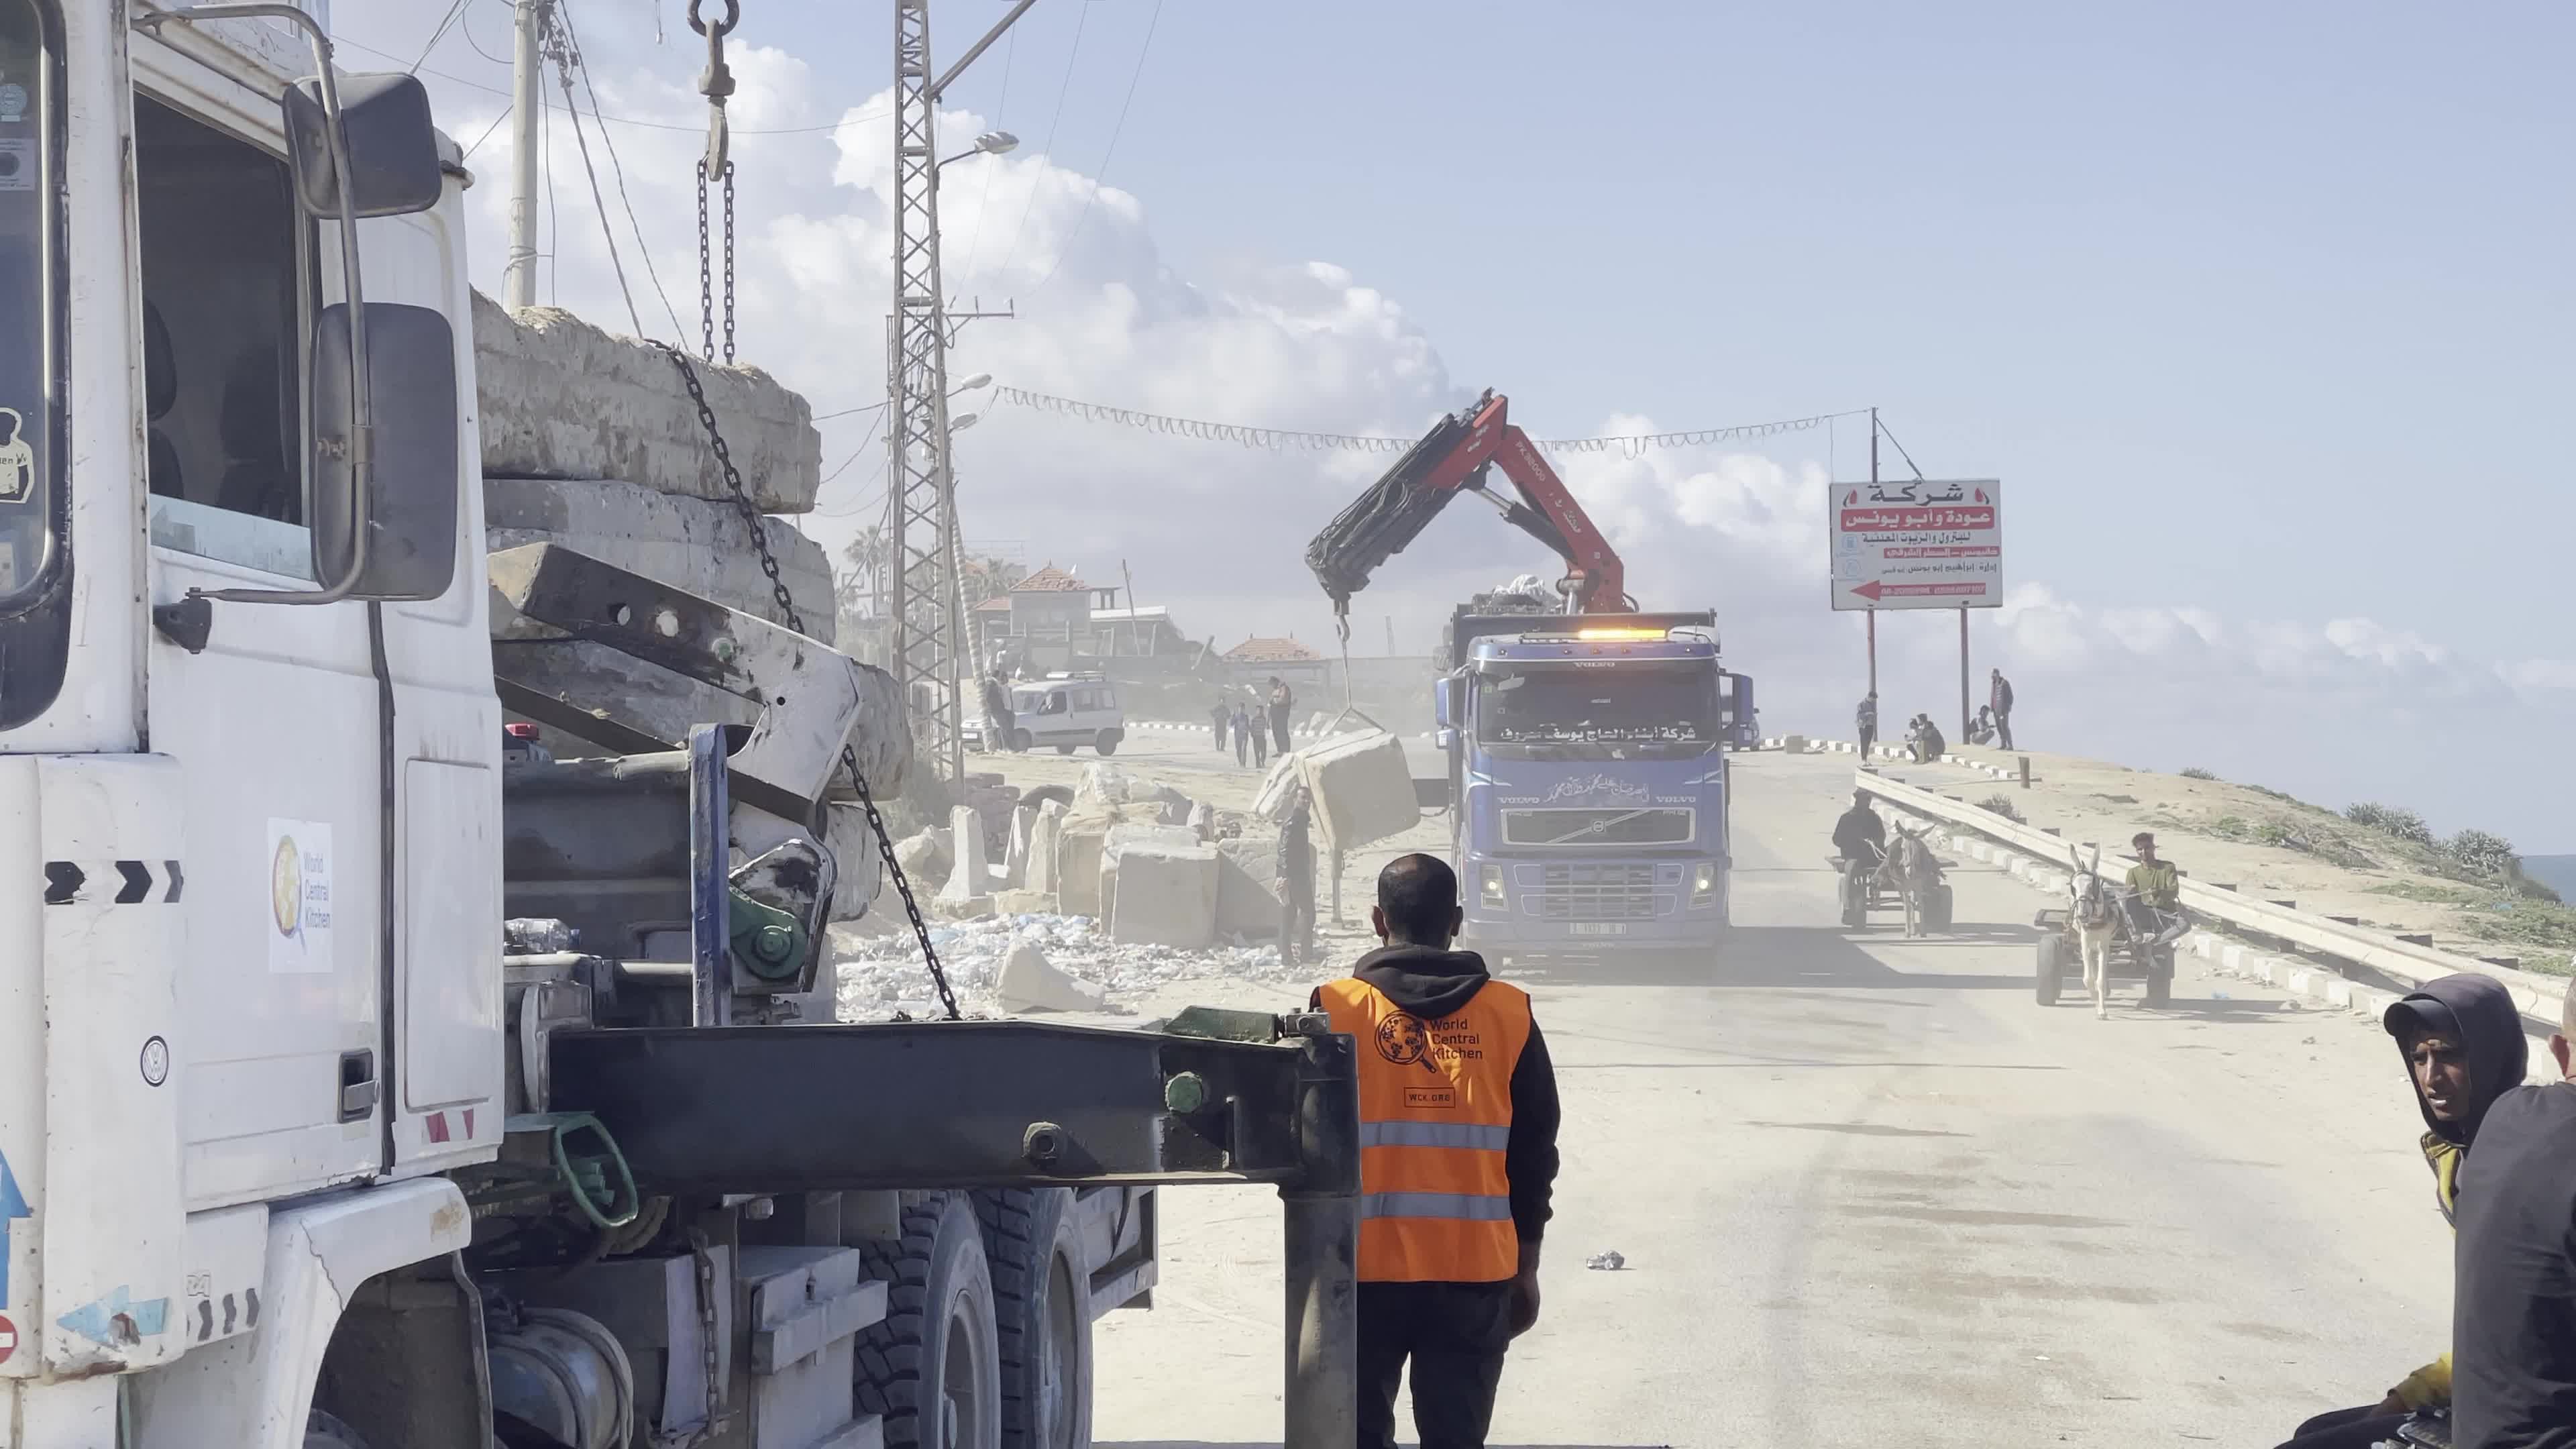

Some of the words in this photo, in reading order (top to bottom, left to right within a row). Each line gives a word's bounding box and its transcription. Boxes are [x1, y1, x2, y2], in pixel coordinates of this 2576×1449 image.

[1867, 479, 1964, 506] شركة
[1845, 510, 1900, 528] يونس
[1945, 509, 1991, 527] عودة
[1587, 727, 1624, 742] الحاج
[1660, 726, 1696, 742] شركة
[1498, 796, 1540, 804] VOLVO
[304, 851, 323, 873] World
[305, 879, 329, 902] Central
[305, 907, 331, 928] Kitchen
[1430, 1018, 1468, 1031] World
[1432, 1033, 1480, 1044] Central
[1432, 1047, 1483, 1060] Kitchen
